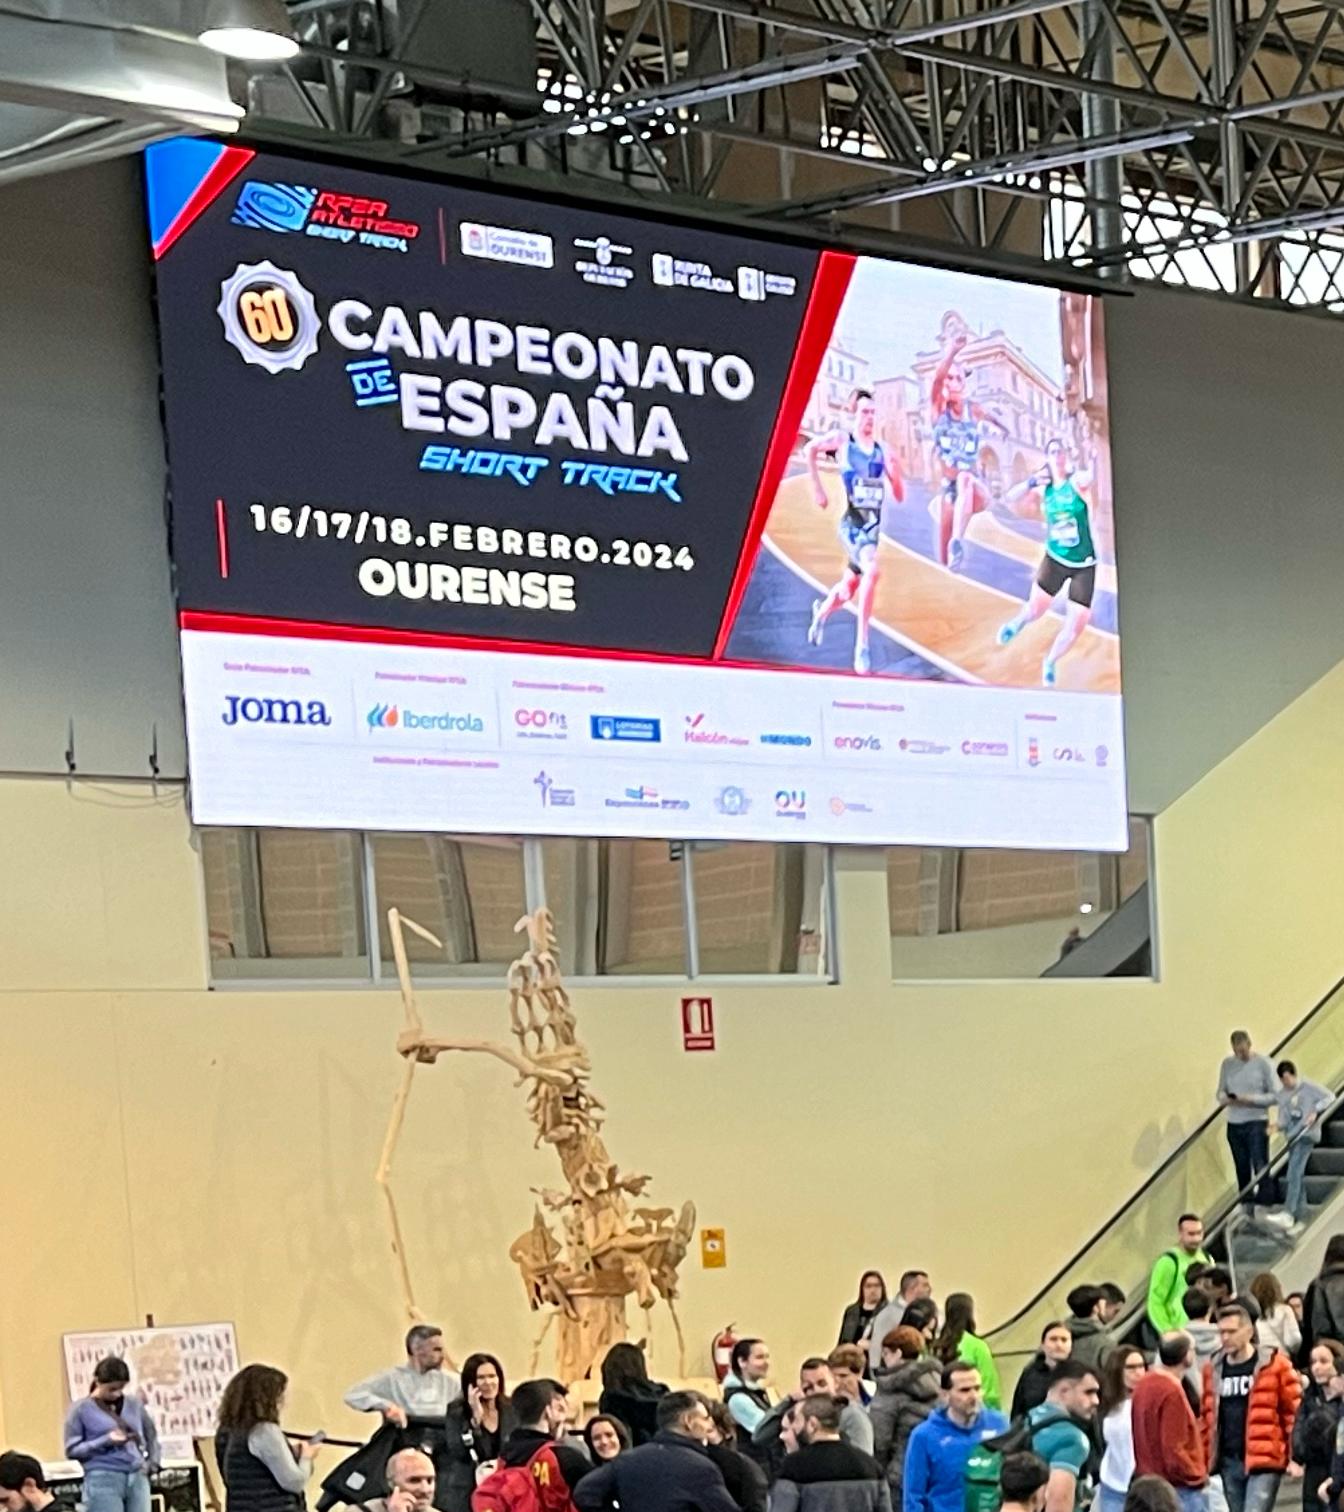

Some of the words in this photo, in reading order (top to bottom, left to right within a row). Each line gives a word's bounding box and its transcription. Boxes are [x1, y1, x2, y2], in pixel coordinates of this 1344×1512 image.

[328, 299, 755, 401] CAMPEONATO
[352, 367, 397, 394] DE
[401, 372, 690, 463] ESPAÑA
[419, 445, 550, 486] SHORT
[560, 460, 684, 503] TRACK
[250, 503, 696, 572] 16/17/18.FEBRERO.2024
[358, 558, 578, 612] OURENSE
[402, 710, 484, 732] Iberdrola
